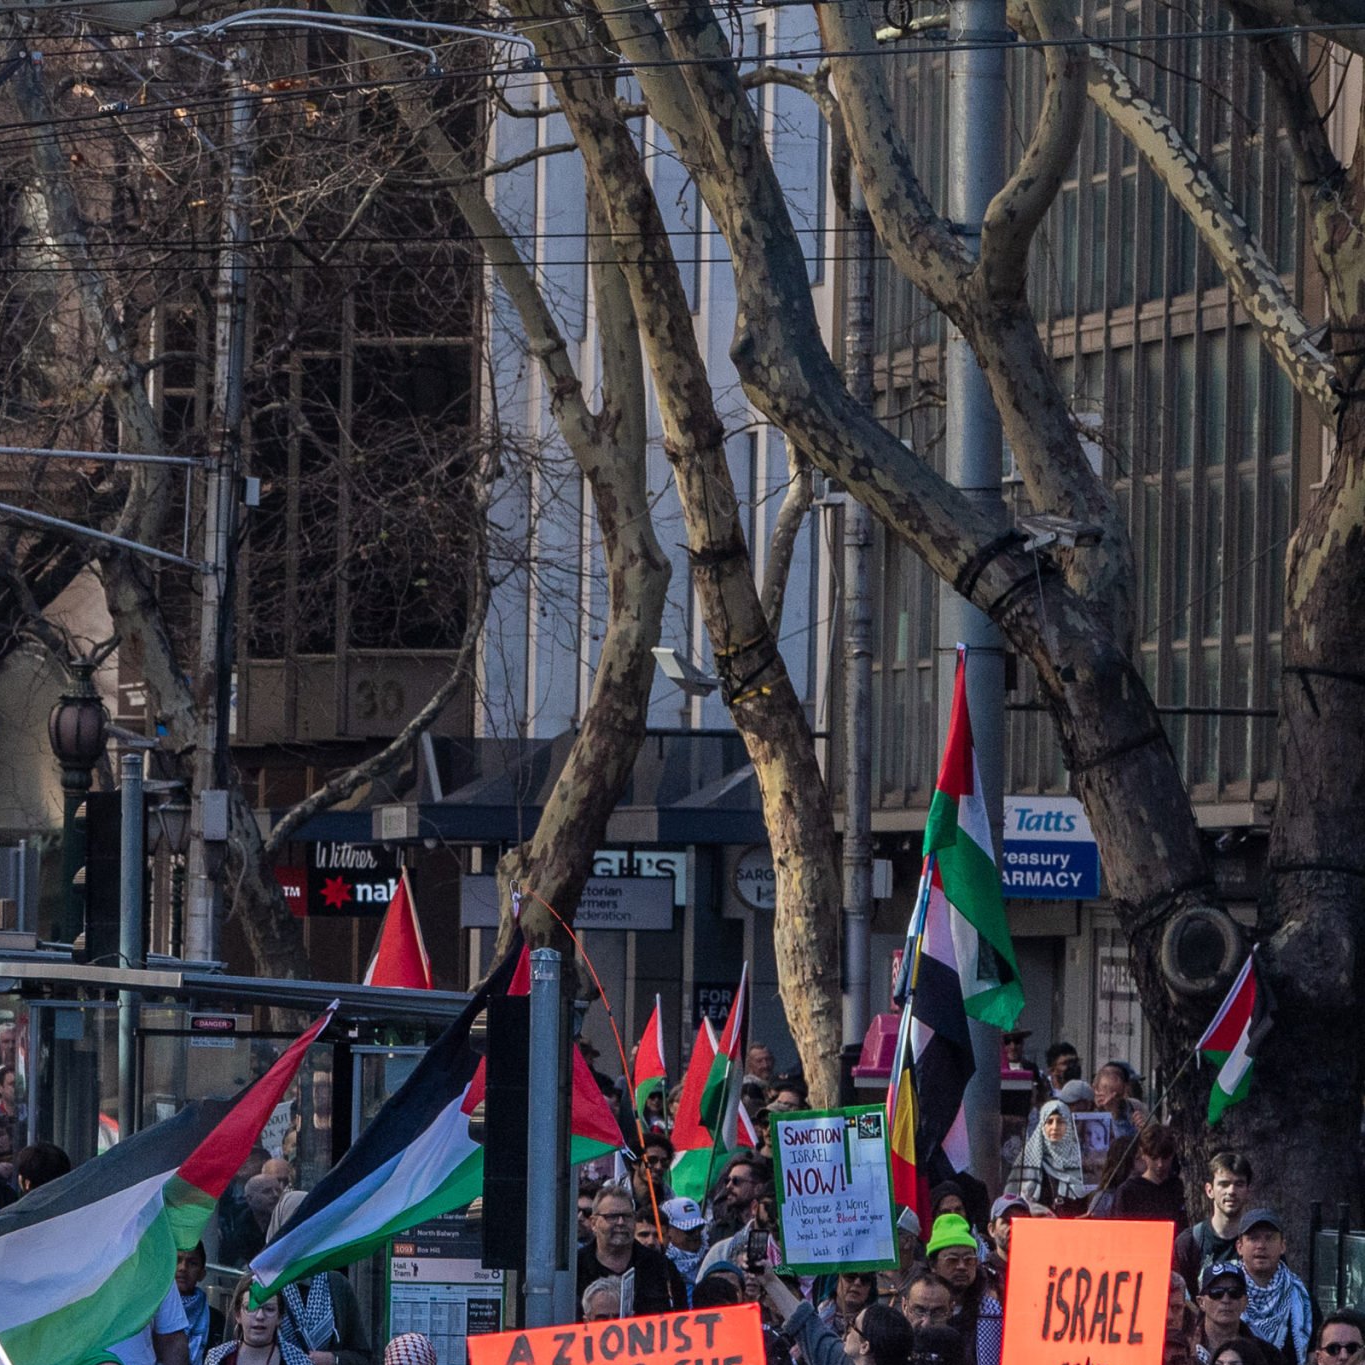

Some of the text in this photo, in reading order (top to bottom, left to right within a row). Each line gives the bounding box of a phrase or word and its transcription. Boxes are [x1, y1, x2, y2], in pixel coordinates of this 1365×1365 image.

[1015, 808, 1077, 832] Tatts
[316, 841, 377, 869] Wittner
[283, 886, 301, 897] TM
[699, 989, 731, 1003] FOR
[791, 1149, 832, 1165] ISRAEL
[787, 1163, 847, 1197] NOW!
[791, 1201, 832, 1216] Albanese
[436, 1230, 460, 1238] Balwyn
[470, 1302, 493, 1310] Where's
